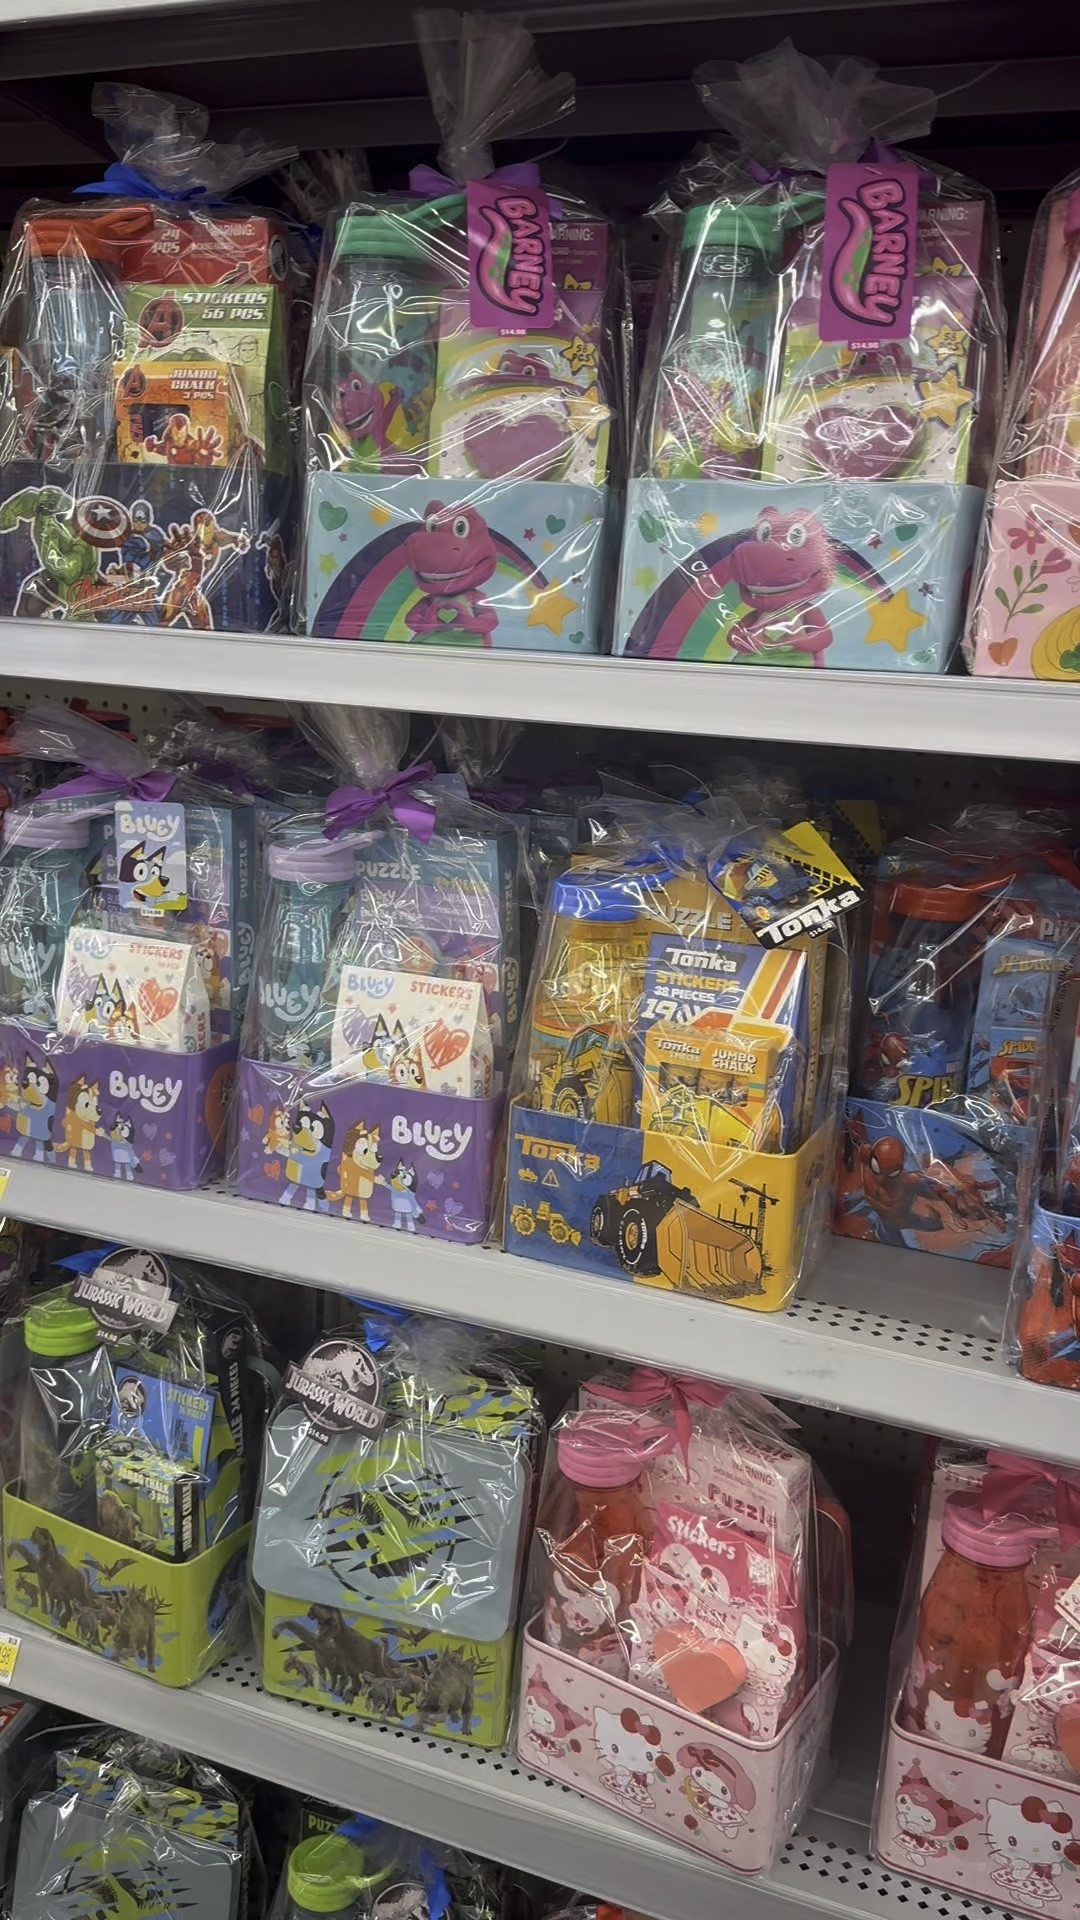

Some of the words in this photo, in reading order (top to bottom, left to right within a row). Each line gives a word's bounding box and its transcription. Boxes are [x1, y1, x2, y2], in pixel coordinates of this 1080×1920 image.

[913, 206, 969, 222] ARNING:
[161, 229, 181, 241] 24
[497, 196, 546, 315] BARNEY
[857, 178, 908, 326] BARNEY
[181, 292, 268, 305] STICKERS
[169, 369, 218, 379] JUMBO
[170, 380, 216, 390] CHALK
[119, 813, 181, 842] BLUEY
[355, 861, 422, 881] PUZZLE
[756, 889, 861, 945] Tonka
[128, 943, 184, 960] STICKERS
[664, 946, 738, 973] Tonka
[347, 973, 396, 1000] BLUEY
[409, 981, 473, 1001] STICKERS
[655, 971, 742, 993] STICKERS
[671, 987, 717, 1003] PIECES
[711, 1047, 759, 1066] JUMBO
[711, 1057, 757, 1075] CHALK
[109, 1070, 183, 1114] BLUEY
[391, 1115, 474, 1162] BLUEY
[514, 1133, 601, 1169] Tonka
[73, 1280, 123, 1310] JURASSIC
[121, 1294, 170, 1324] WORLD
[285, 1369, 335, 1407] JURASSIC
[332, 1392, 380, 1429] WORLD
[181, 1514, 194, 1552] JUMBO
